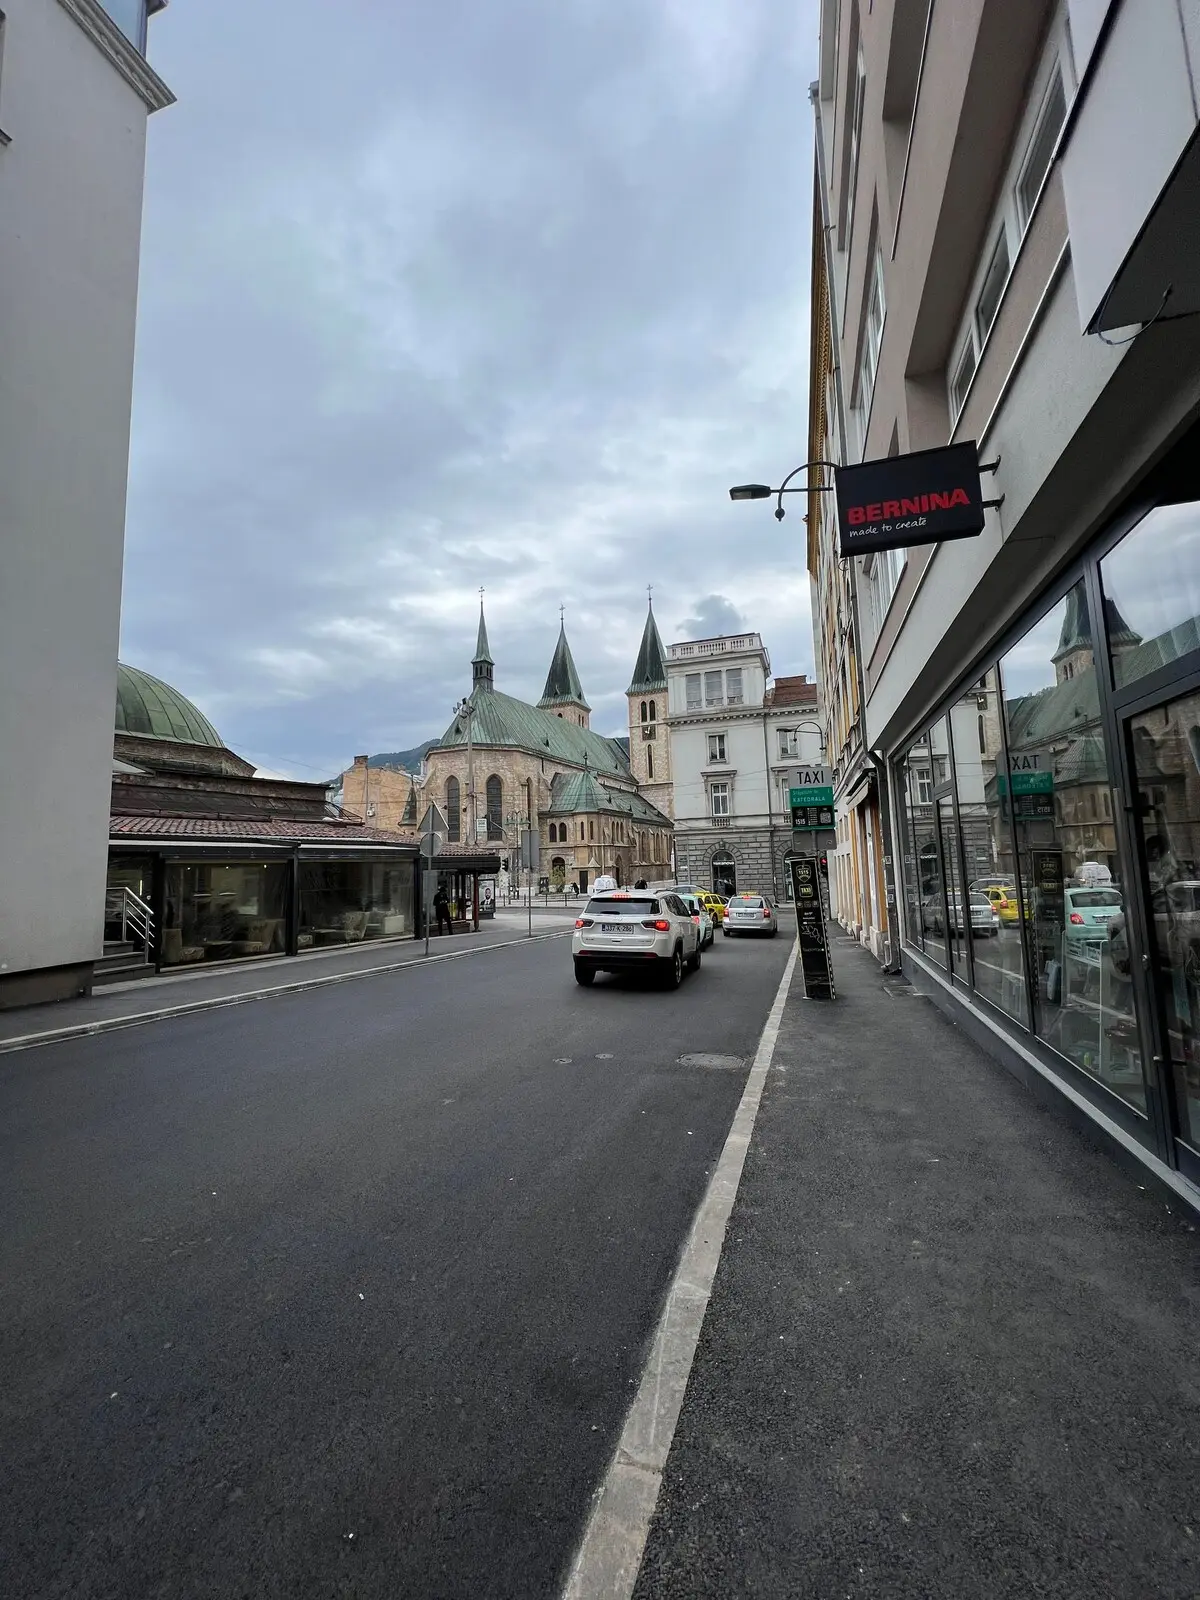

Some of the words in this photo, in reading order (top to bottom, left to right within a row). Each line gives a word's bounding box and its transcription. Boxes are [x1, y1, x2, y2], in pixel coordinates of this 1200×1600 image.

[847, 488, 971, 526] BERNINA
[849, 525, 879, 538] made
[882, 523, 893, 532] to
[895, 516, 927, 530] create
[796, 771, 825, 785] TAXI
